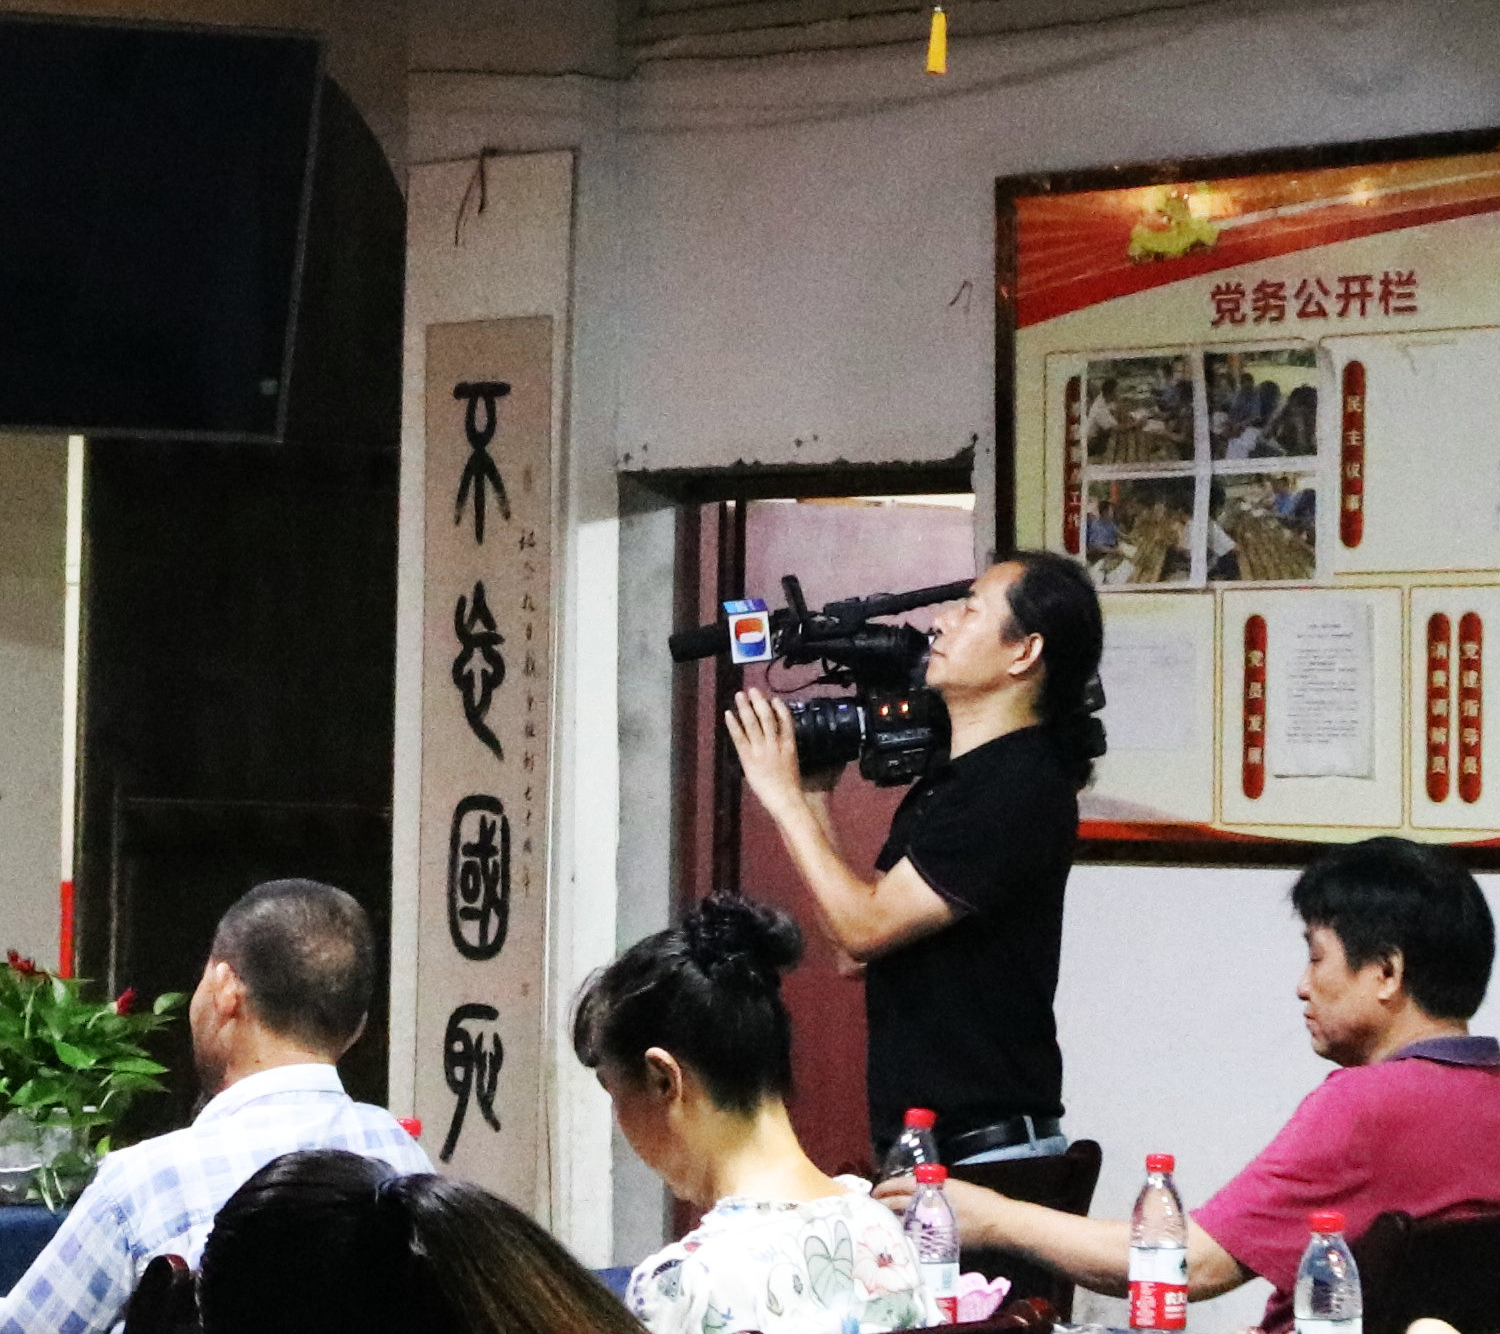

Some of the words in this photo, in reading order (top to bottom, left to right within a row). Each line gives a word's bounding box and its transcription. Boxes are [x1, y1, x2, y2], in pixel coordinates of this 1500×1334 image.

[1210, 269, 1420, 327] 党务公开栏
